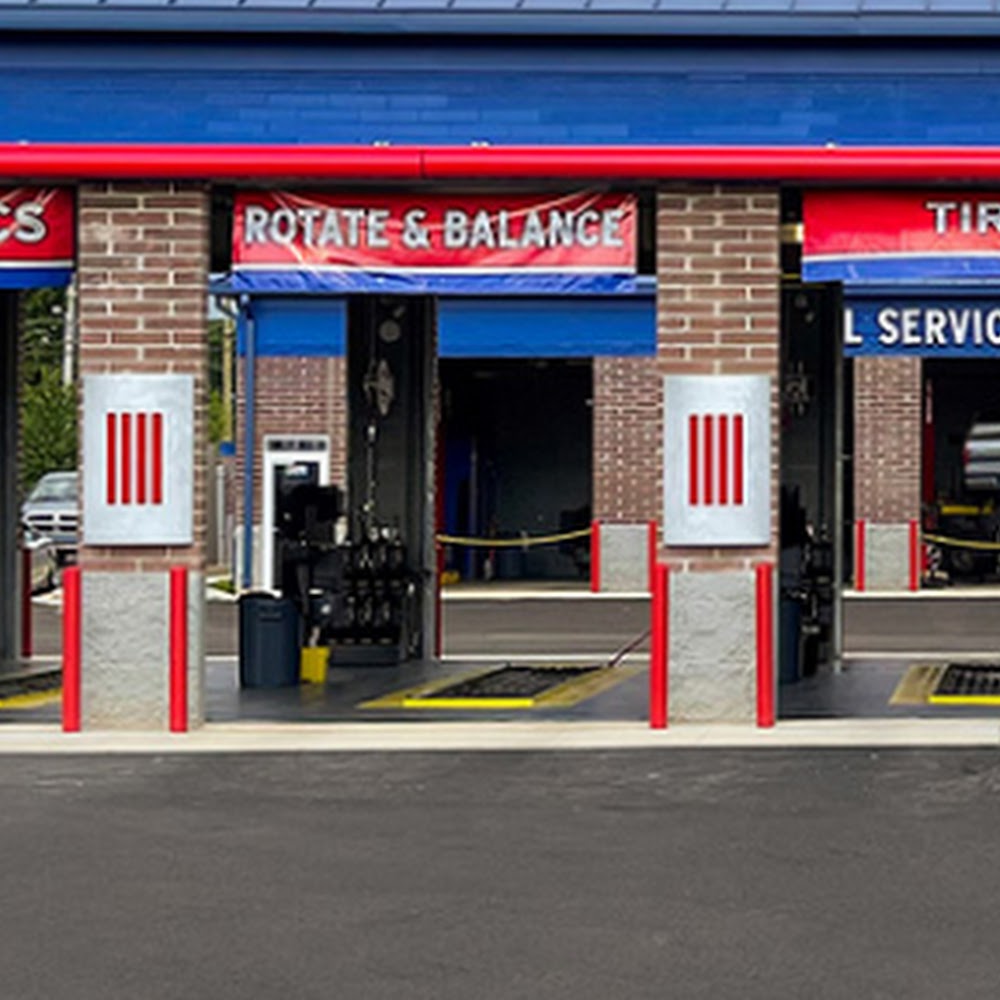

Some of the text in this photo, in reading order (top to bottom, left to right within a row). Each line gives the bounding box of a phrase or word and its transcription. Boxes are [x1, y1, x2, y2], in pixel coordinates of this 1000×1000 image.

[245, 205, 624, 248] ROTATE & BALANCE
[844, 308, 863, 345] L
